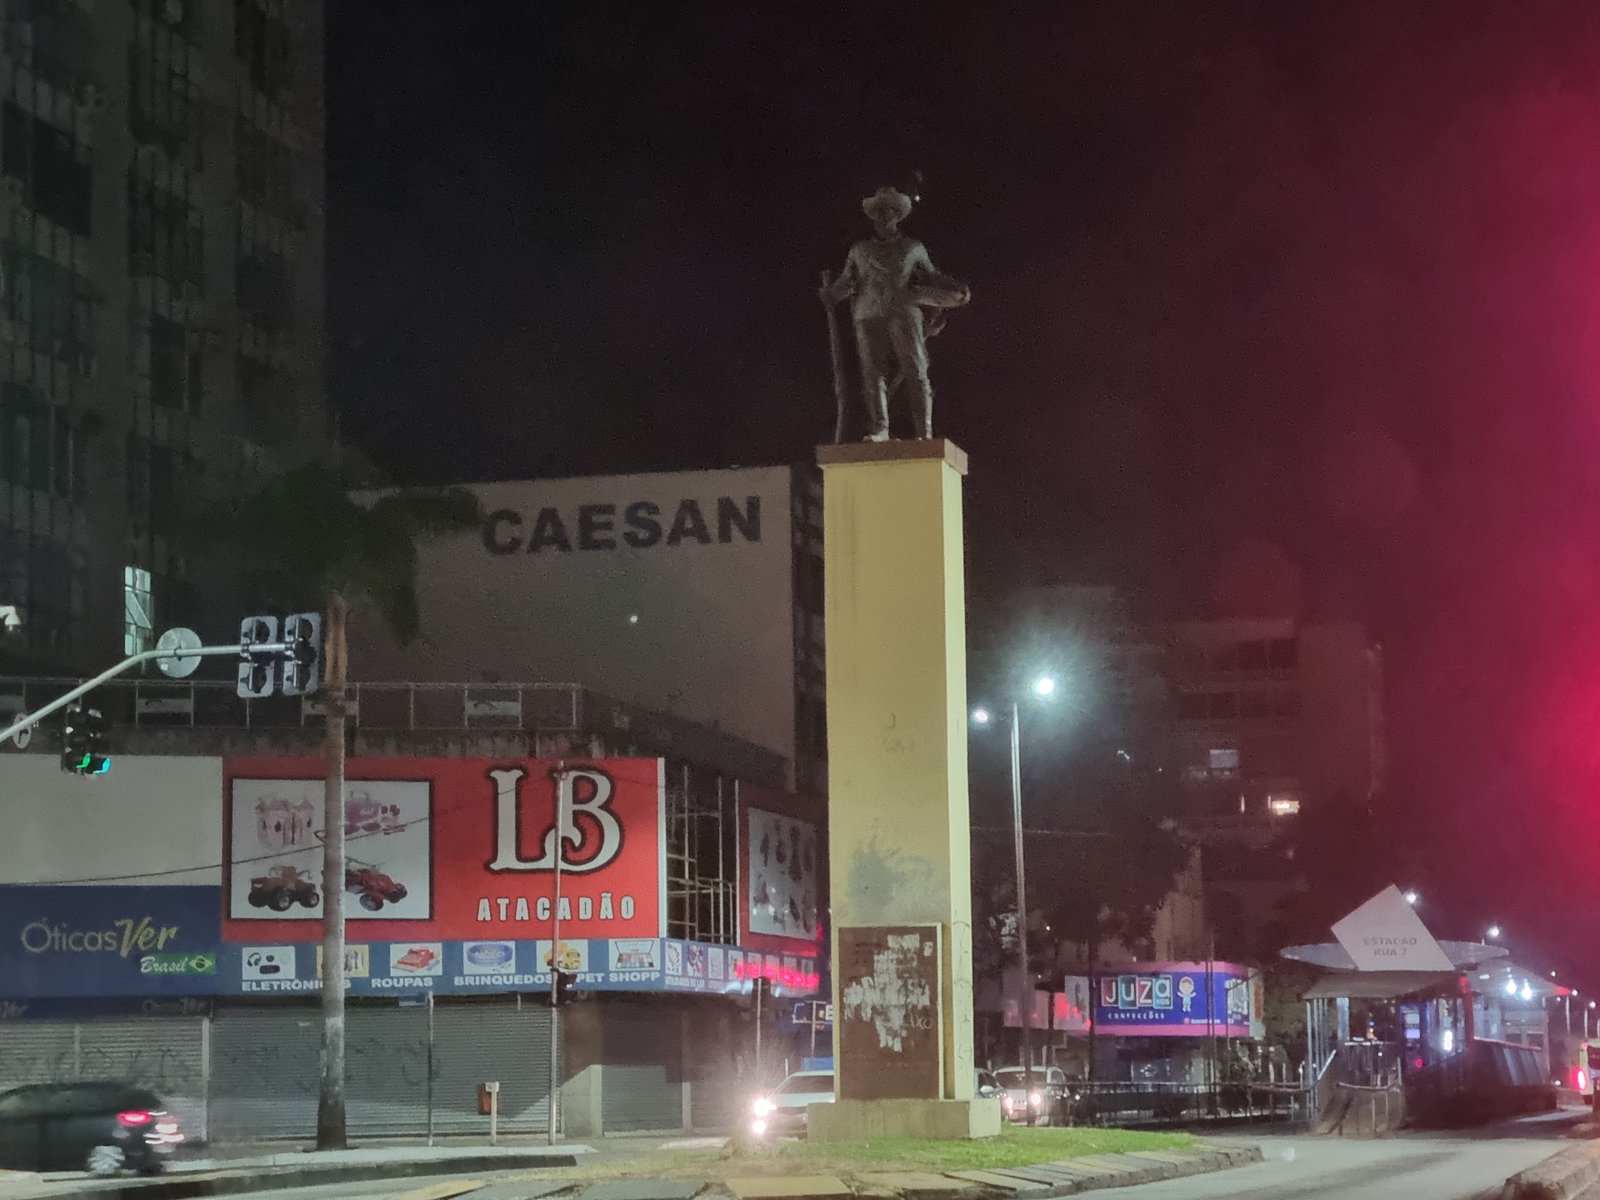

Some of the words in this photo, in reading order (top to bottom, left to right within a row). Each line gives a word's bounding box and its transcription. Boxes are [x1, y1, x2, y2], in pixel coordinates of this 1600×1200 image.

[482, 495, 761, 556] CAESAN
[488, 767, 624, 873] LB
[477, 892, 636, 922] ATACADÃO
[140, 955, 188, 974] Brasil
[242, 977, 352, 992] ELETRÔNIS
[371, 976, 434, 988] ROUPAS
[608, 971, 661, 983] SHOPP
